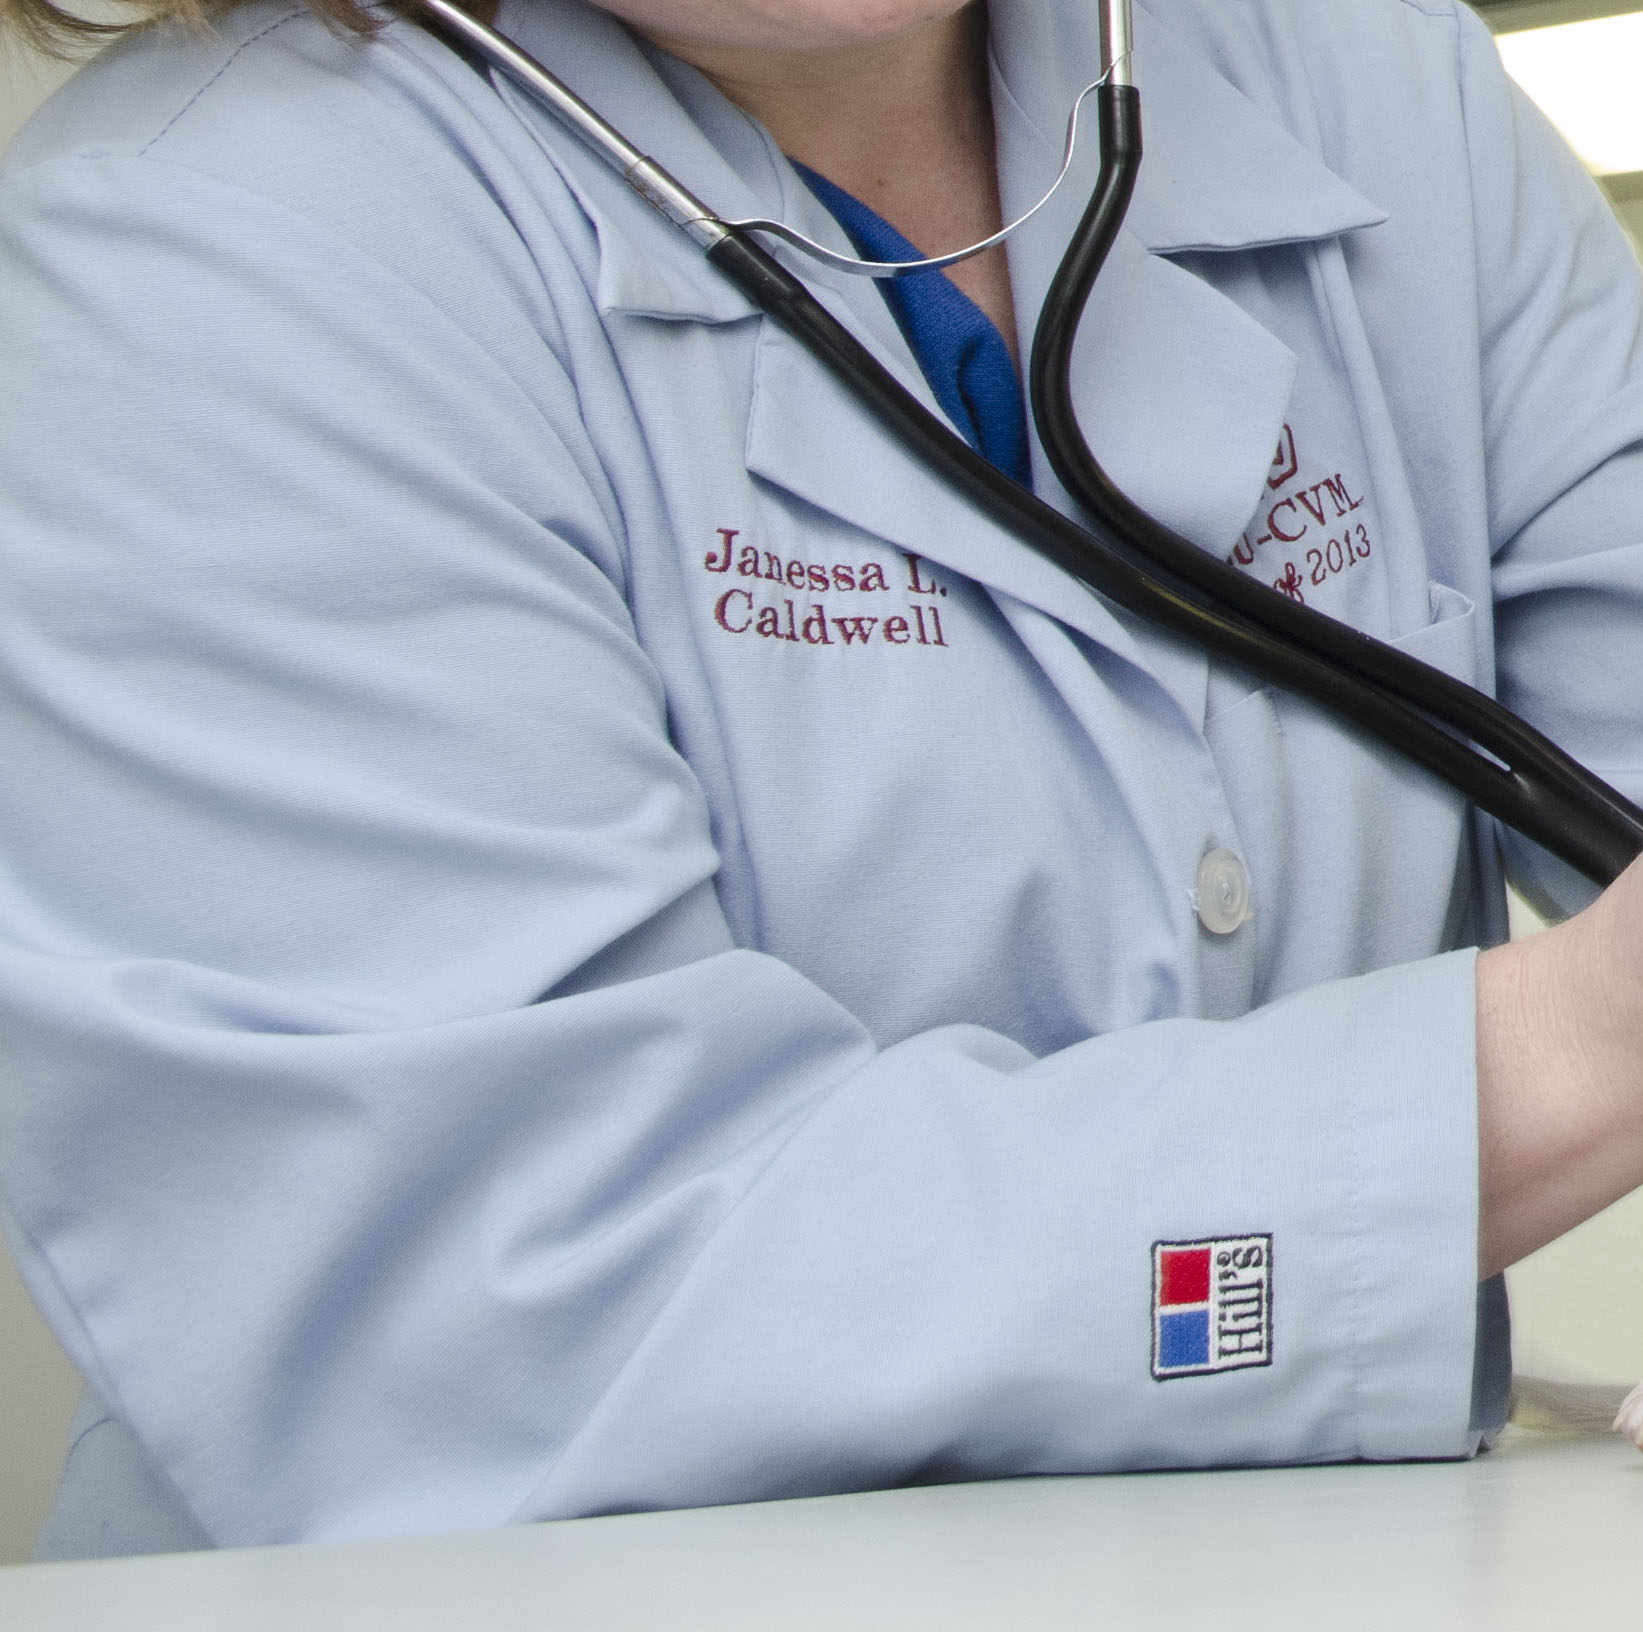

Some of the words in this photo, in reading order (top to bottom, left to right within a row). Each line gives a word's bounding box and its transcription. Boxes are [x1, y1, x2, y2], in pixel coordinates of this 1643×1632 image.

[704, 528, 890, 592] Janessa
[902, 552, 948, 598] L.
[1306, 523, 1371, 586] 2013
[714, 588, 949, 647] Caldwell
